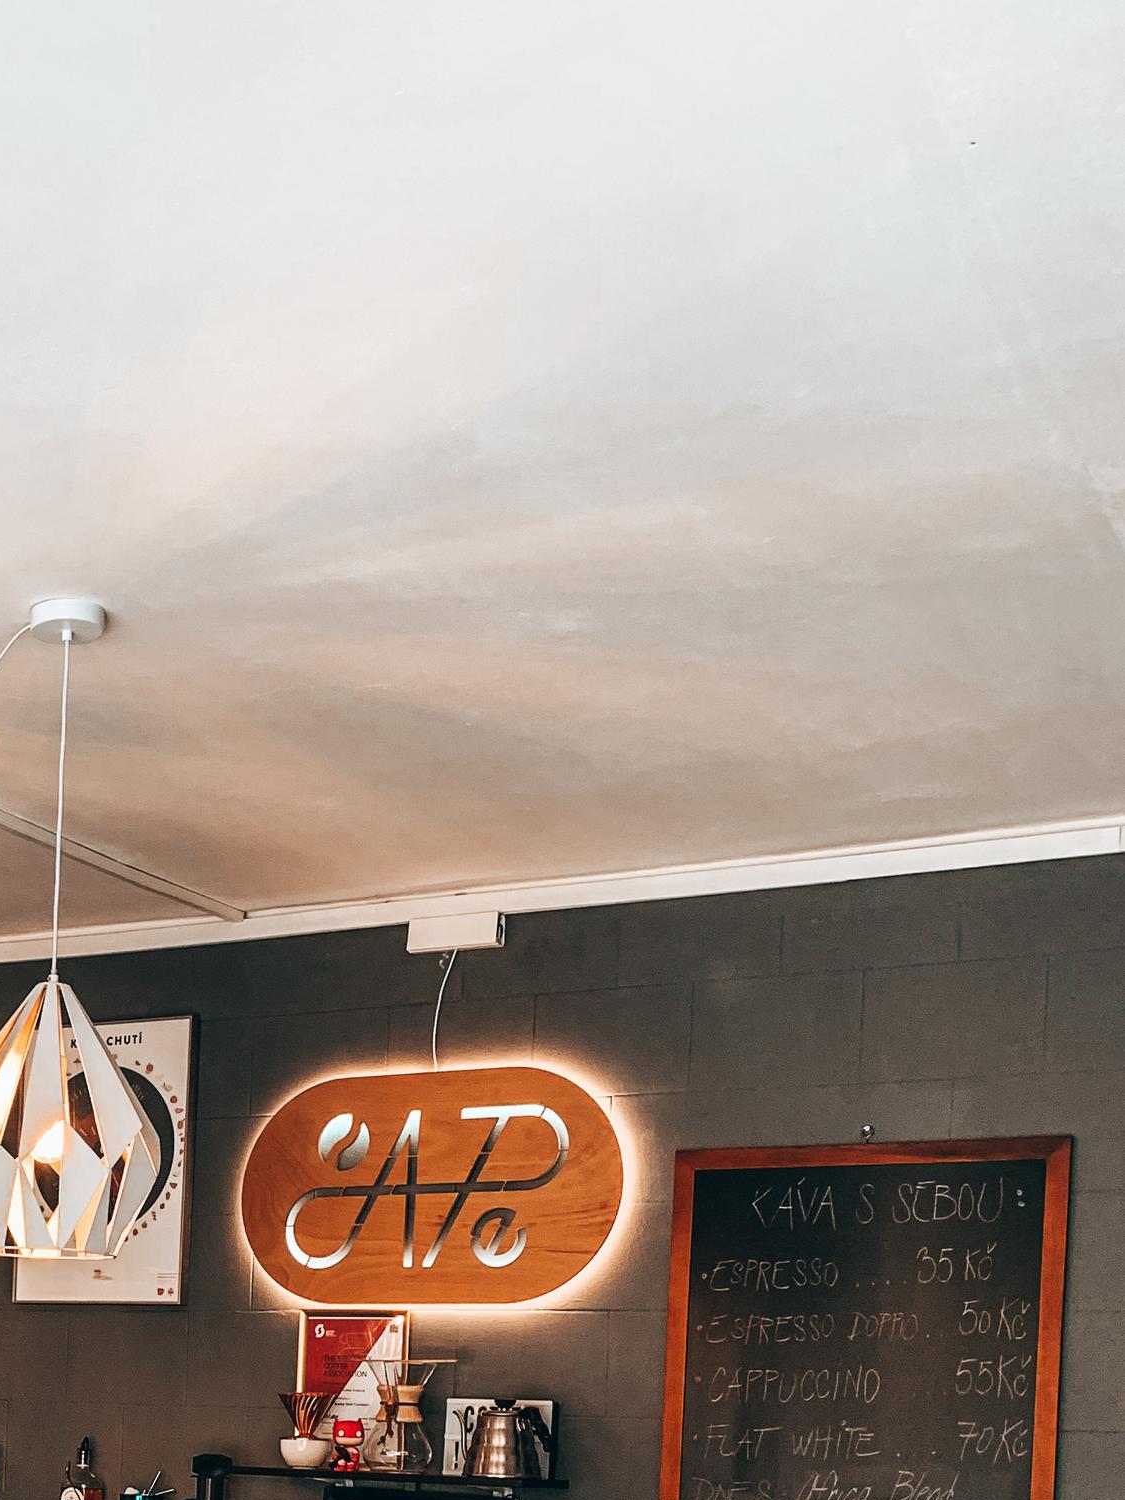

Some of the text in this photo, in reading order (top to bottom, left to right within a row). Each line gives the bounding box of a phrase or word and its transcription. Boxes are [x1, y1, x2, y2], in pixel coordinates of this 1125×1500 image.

[106, 1031, 143, 1047] CHUTÍ
[752, 1177, 837, 1230] KÁVA
[855, 1183, 875, 1225] S
[709, 1257, 839, 1291] ESPRESSO
[705, 1312, 837, 1345] ESPRESSO
[707, 1365, 881, 1403] CAPPUCCINO
[704, 1424, 783, 1460] FLAT
[791, 1419, 881, 1460] WHITE
